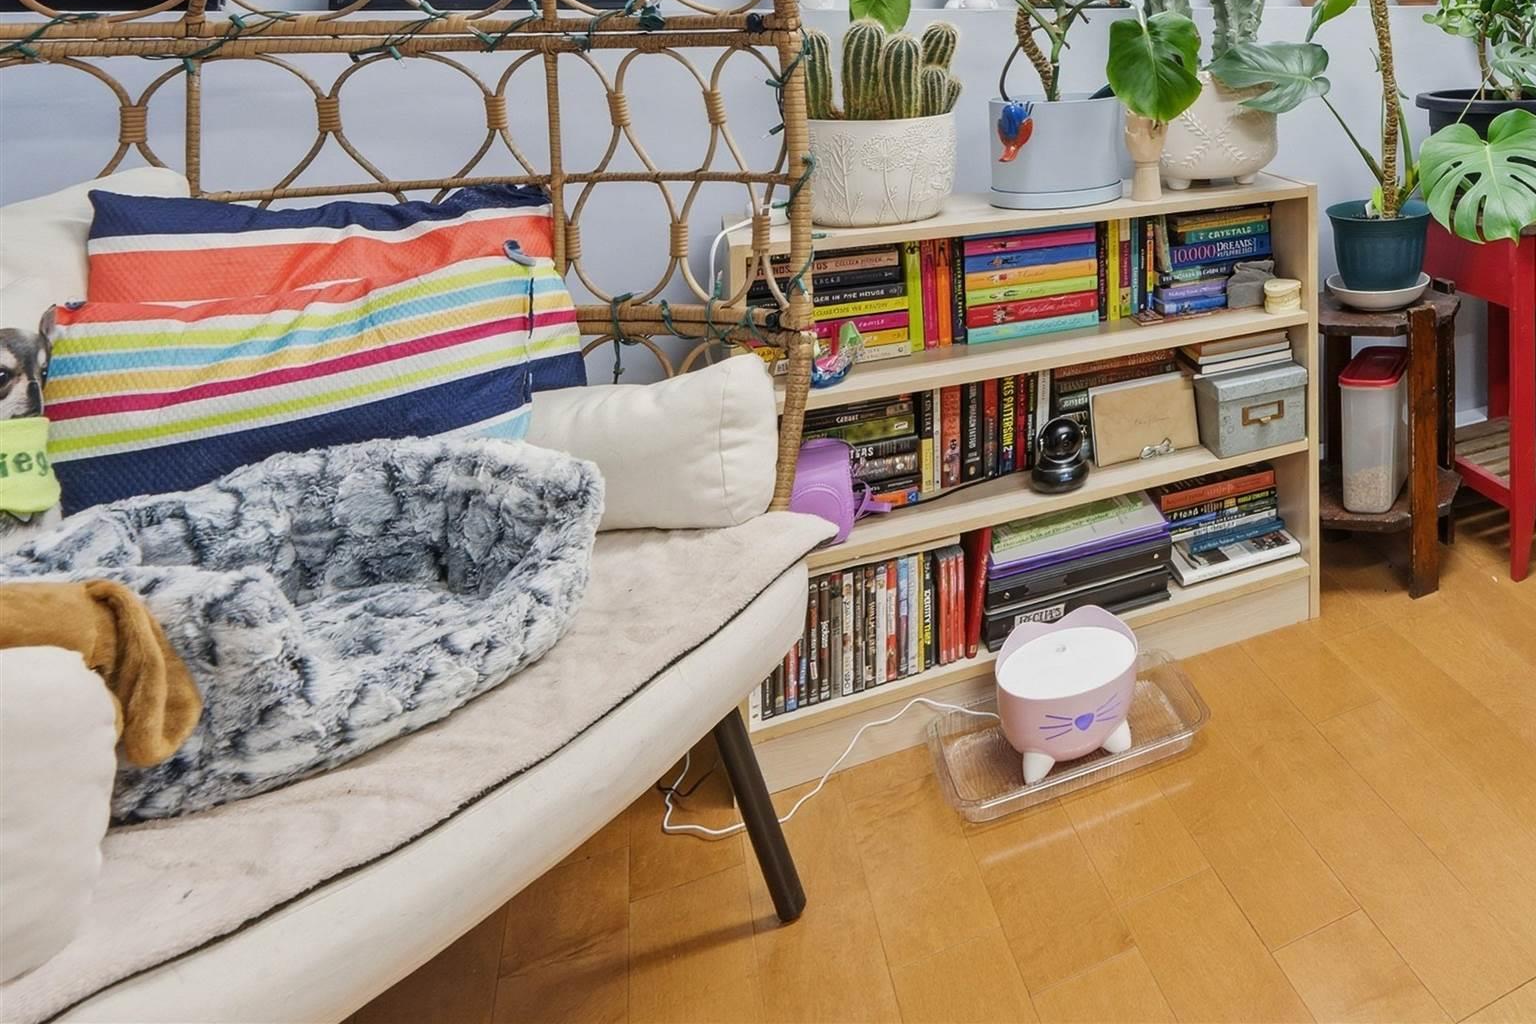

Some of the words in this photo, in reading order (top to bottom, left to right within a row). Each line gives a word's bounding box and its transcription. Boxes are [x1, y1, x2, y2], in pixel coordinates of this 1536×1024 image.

[1208, 226, 1252, 240] CRYSTALS
[859, 288, 885, 298] HOUSE
[1002, 396, 1016, 446] PATTERSON
